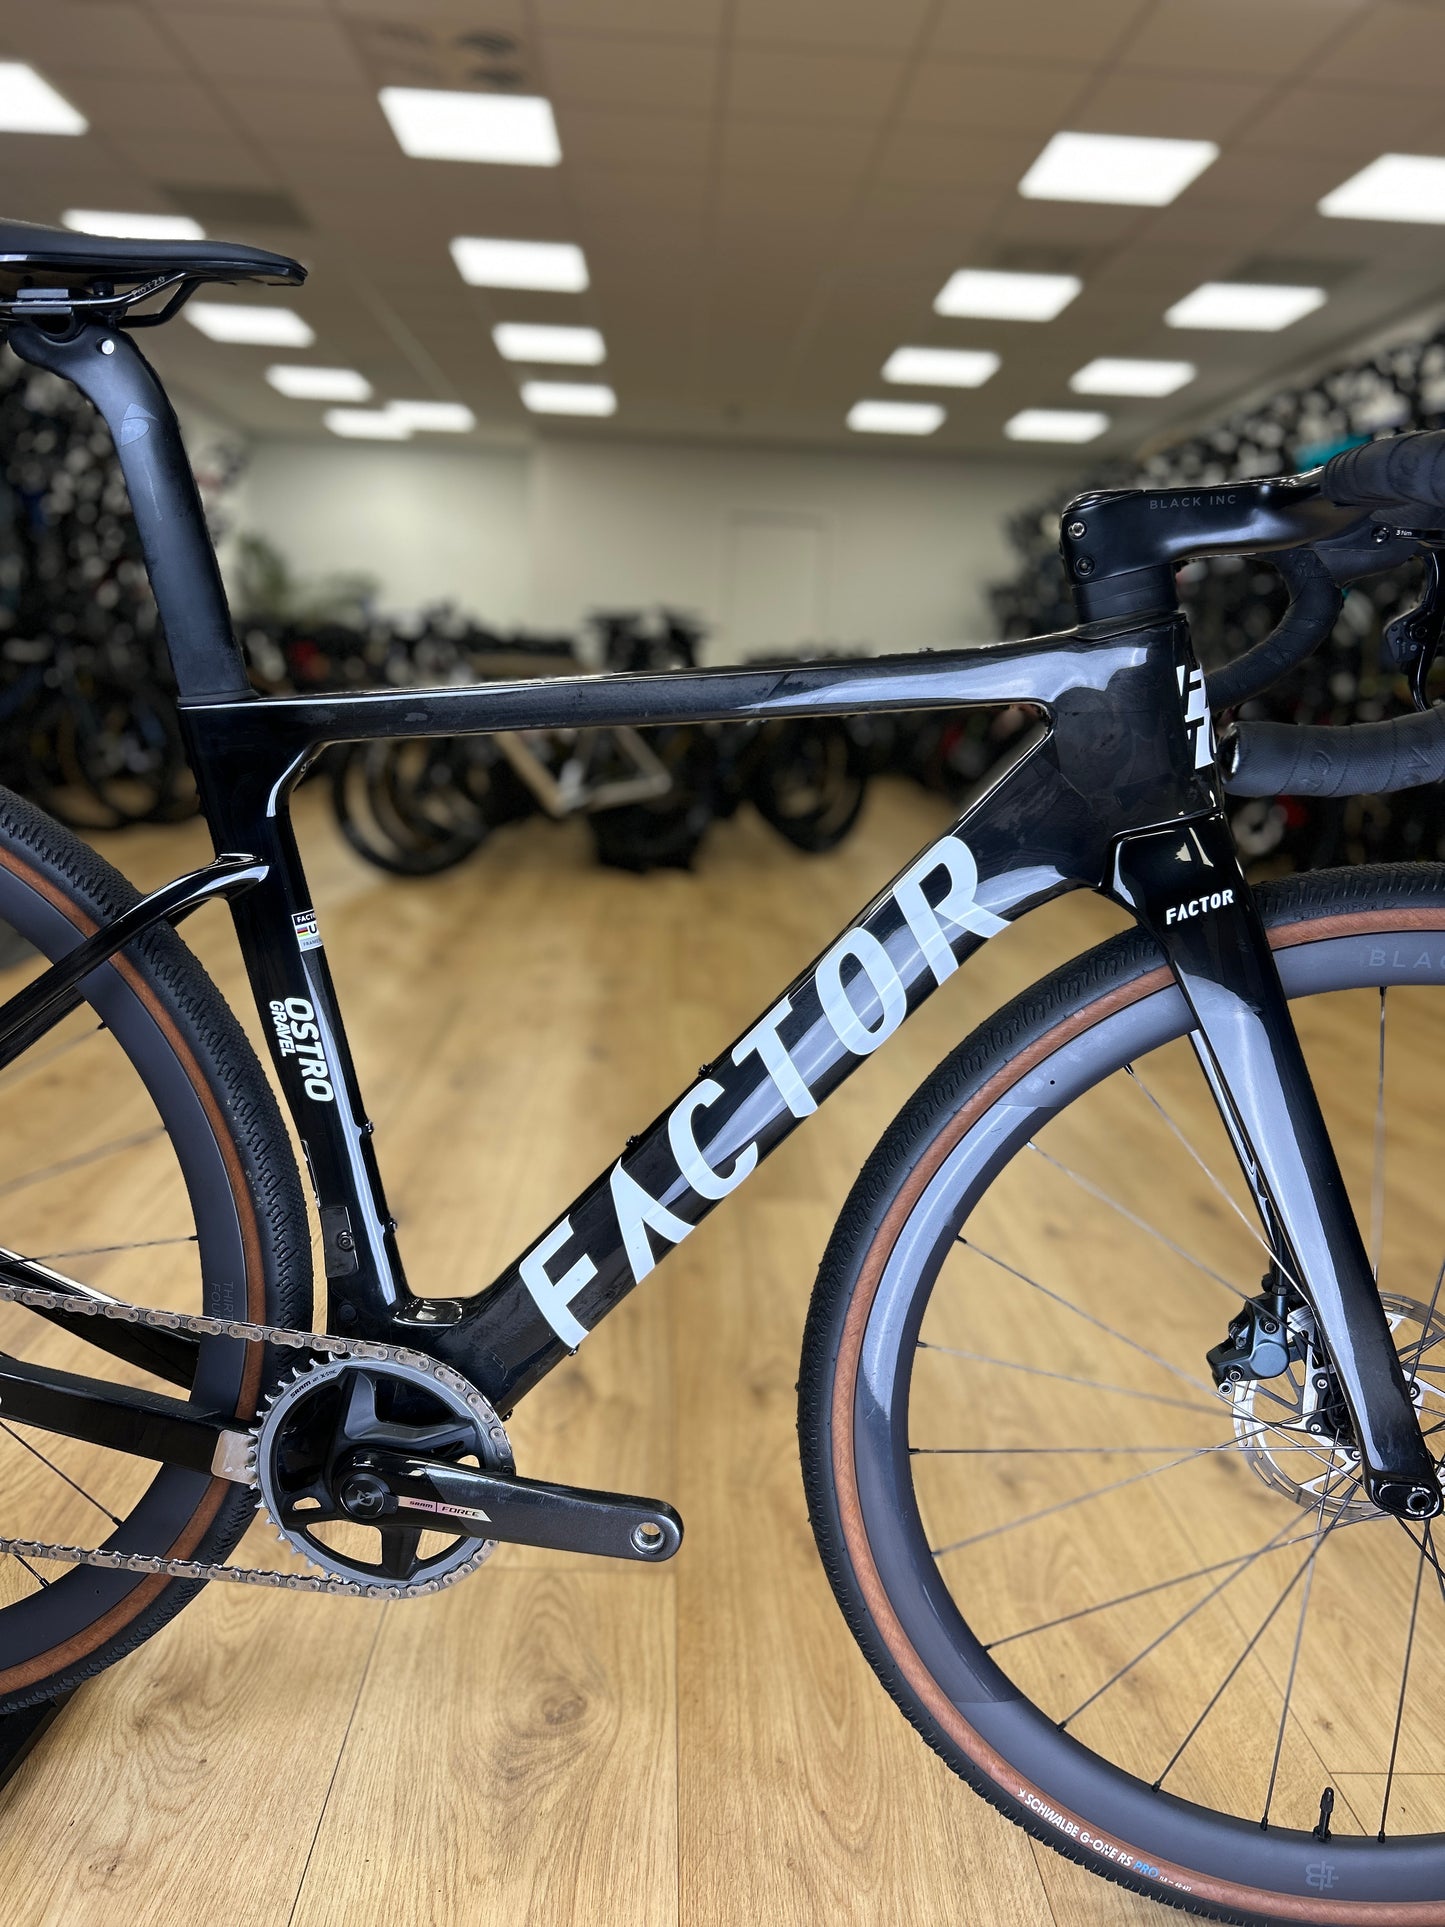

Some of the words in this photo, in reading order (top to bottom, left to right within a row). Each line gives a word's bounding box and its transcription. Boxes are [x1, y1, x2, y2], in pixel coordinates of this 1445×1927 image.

[1149, 497, 1201, 509] BLACK
[1209, 495, 1236, 505] INC
[1166, 889, 1234, 925] FACTOR
[269, 1000, 296, 1057] GRAVEL
[284, 997, 334, 1102] OSTRO
[518, 835, 1012, 1350] FACTOR
[223, 1281, 234, 1321] THIRT
[290, 1380, 312, 1399] SRAM
[409, 1500, 433, 1509] SRAM
[441, 1506, 479, 1518] FORCE
[1024, 1793, 1080, 1838] SCHWALBE
[1079, 1831, 1119, 1859] G-ONE
[1117, 1852, 1134, 1867] RS
[1133, 1860, 1160, 1878] PRO
